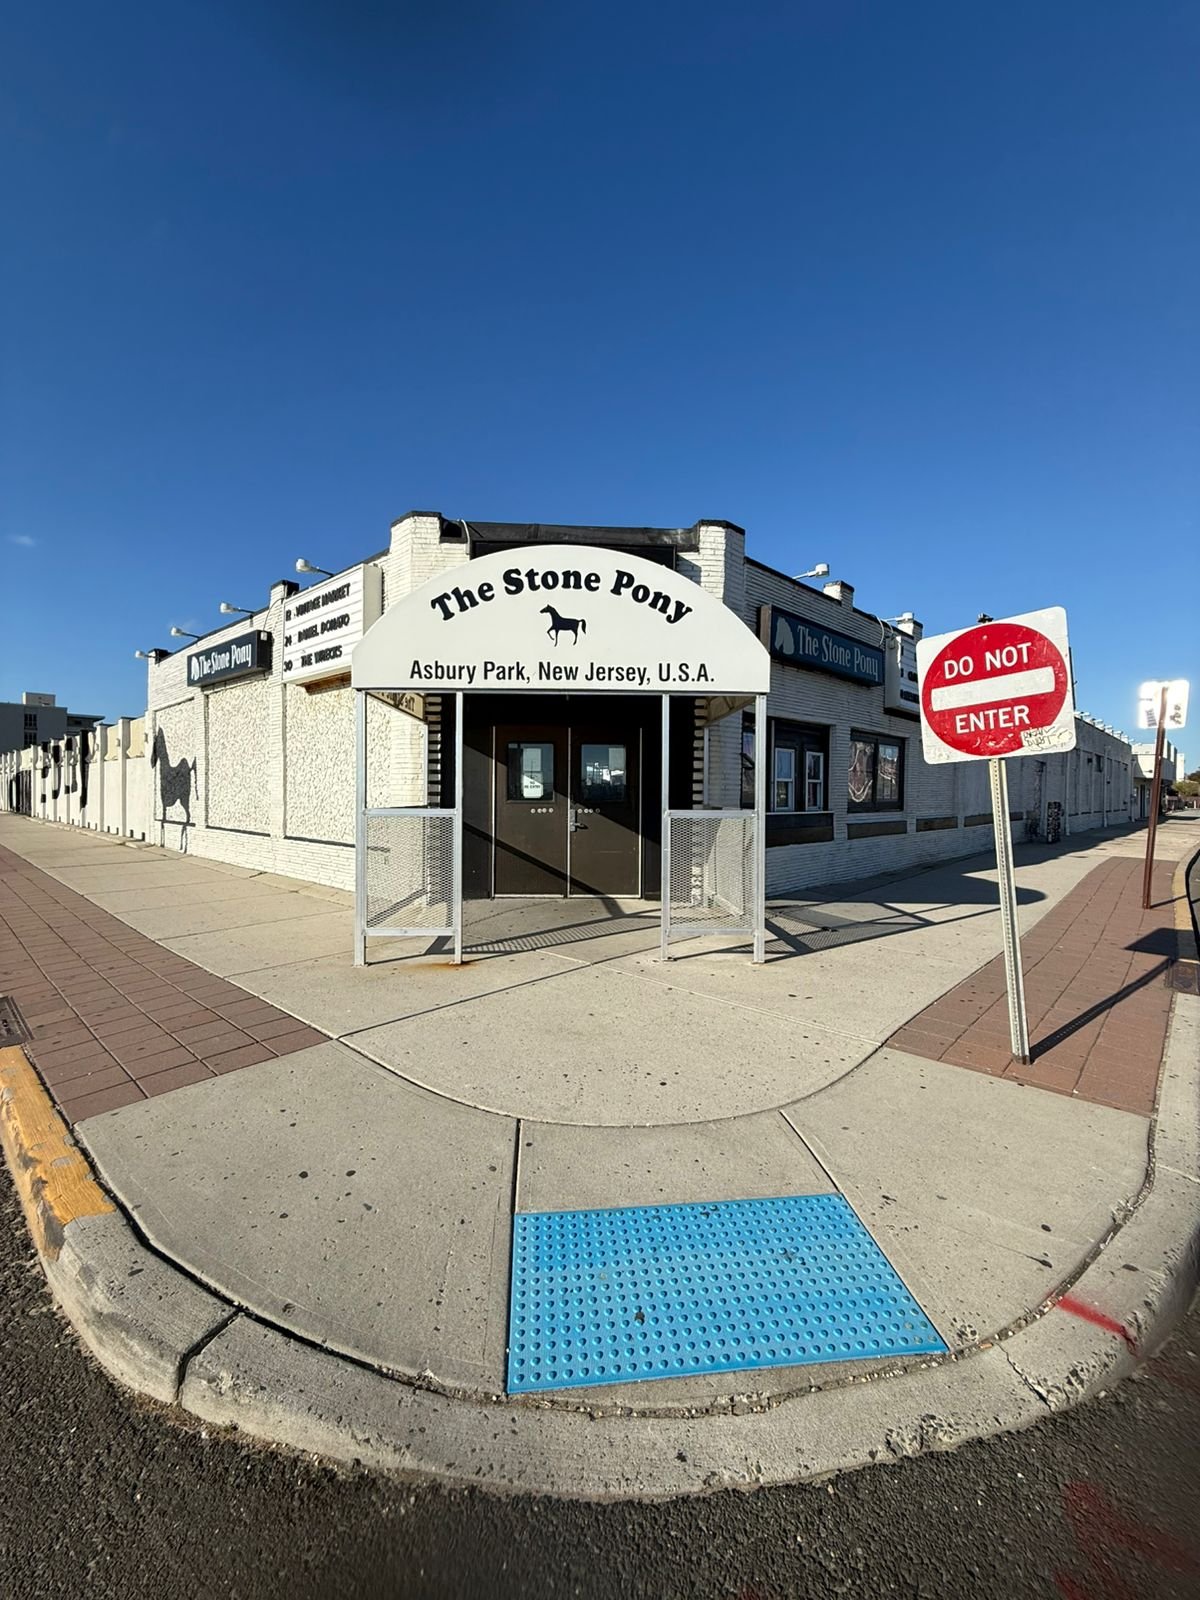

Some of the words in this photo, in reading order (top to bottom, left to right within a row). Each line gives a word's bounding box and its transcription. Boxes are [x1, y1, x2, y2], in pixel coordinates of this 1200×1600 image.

[322, 583, 351, 607] MARKET
[430, 581, 495, 622] The
[502, 567, 601, 596] Stone
[610, 569, 694, 625] Pony
[298, 624, 319, 643] DANIEL
[320, 613, 350, 635] DONATO
[199, 655, 211, 678] The
[211, 651, 230, 674] Stone
[231, 643, 252, 669] Pony
[301, 653, 313, 667] THE
[314, 645, 343, 664] WRECKS
[797, 624, 819, 657] The
[821, 634, 851, 668] Stone
[853, 647, 879, 682] Pony
[944, 655, 975, 680] DO
[984, 642, 1033, 671] NOT
[409, 659, 477, 685] Asbury
[483, 660, 530, 684] Park,
[538, 661, 579, 681] New
[584, 661, 651, 686] Jersey,
[658, 662, 715, 683] U.S.A.
[954, 705, 1031, 735] ENTER
